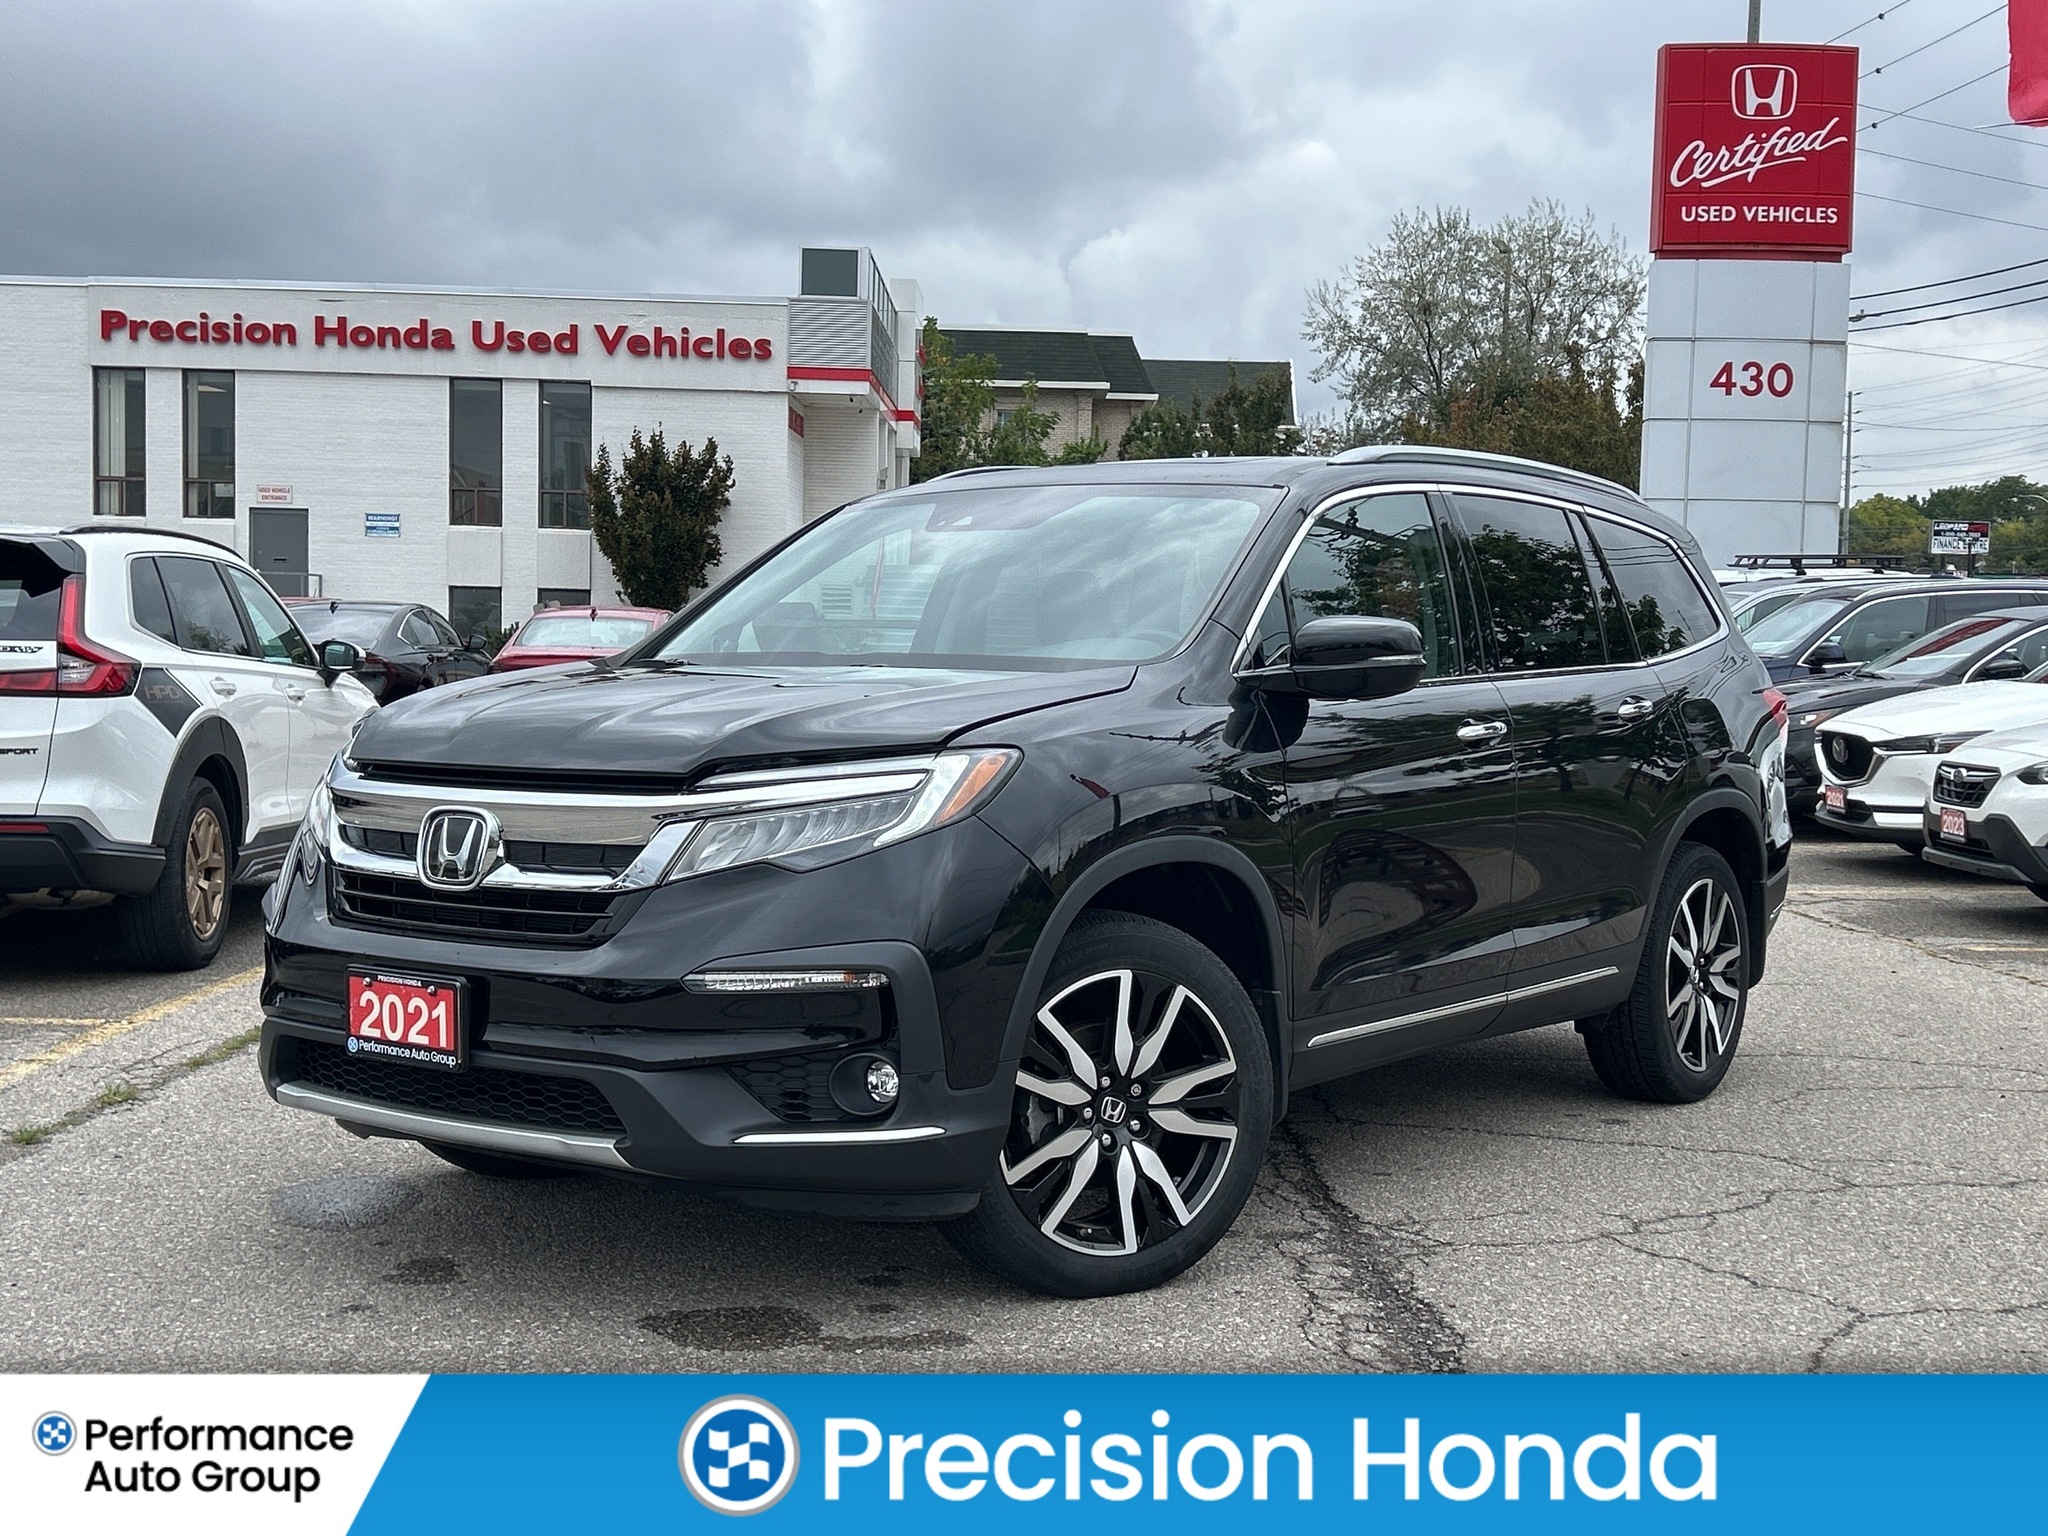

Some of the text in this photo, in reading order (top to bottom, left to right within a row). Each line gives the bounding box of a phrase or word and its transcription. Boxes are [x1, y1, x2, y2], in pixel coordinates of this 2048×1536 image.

[1669, 116, 1849, 189] Certified
[1681, 205, 1839, 225] USED VEHICLES
[101, 310, 772, 360] Precision Honda Used Vehicles
[1710, 361, 1794, 398] 430
[144, 685, 180, 699] HPD
[1942, 814, 1965, 836] 2023
[359, 990, 447, 1049] 2021
[359, 1039, 456, 1068] Performance Auto Group
